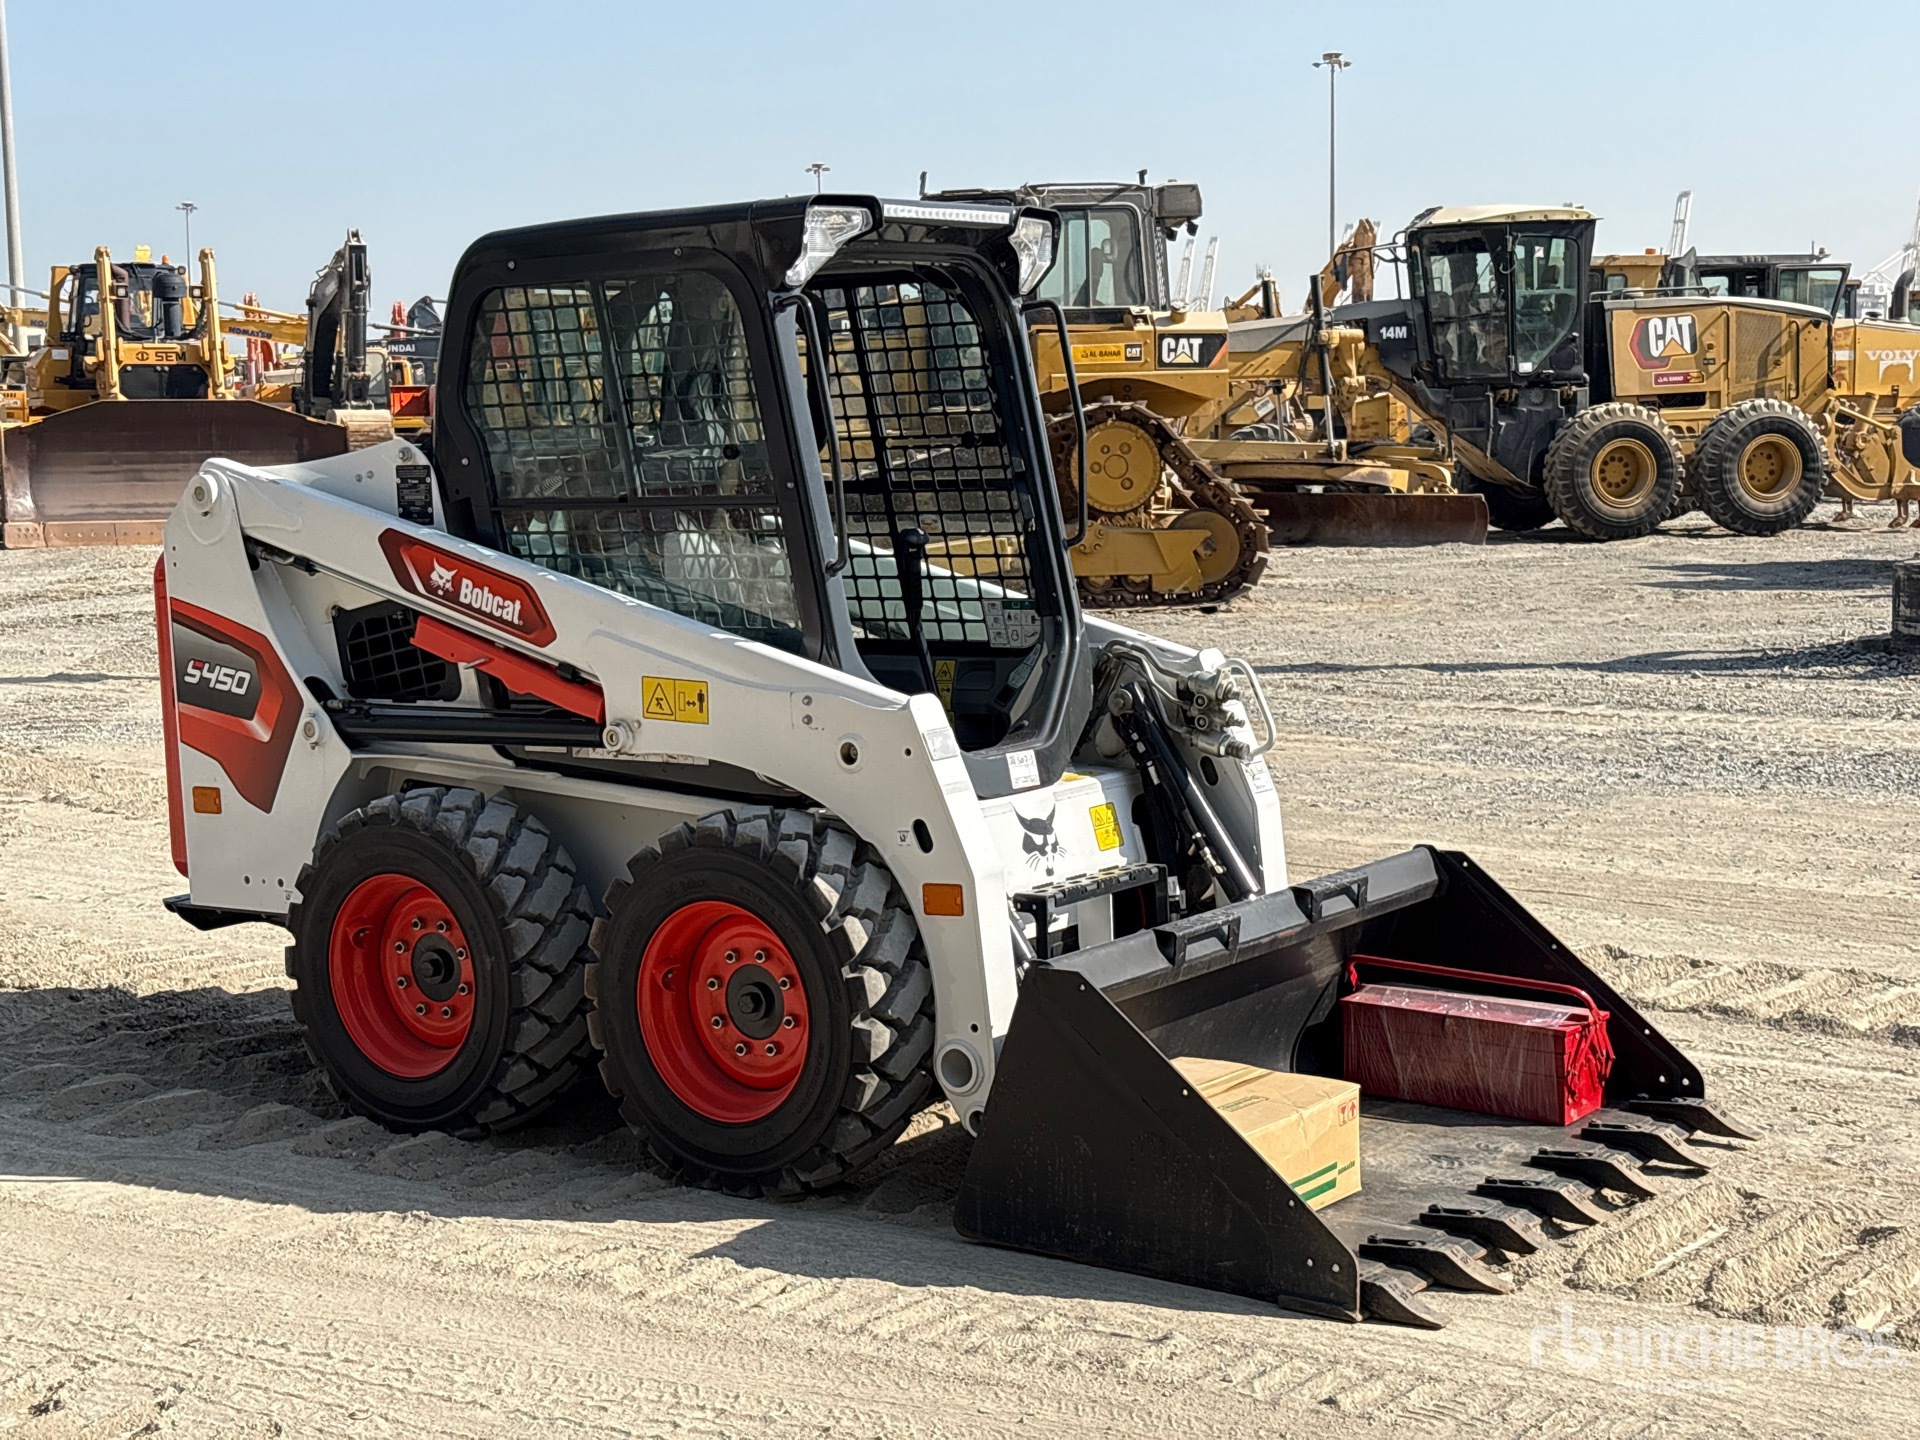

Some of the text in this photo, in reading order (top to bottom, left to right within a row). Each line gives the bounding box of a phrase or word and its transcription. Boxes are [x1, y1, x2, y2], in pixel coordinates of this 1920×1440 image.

[228, 326, 273, 339] KOMATSU
[1379, 326, 1407, 340] 14M
[1648, 316, 1692, 357] CAT
[155, 351, 187, 362] SEM
[1089, 350, 1121, 358] AL-BAHAR
[1126, 347, 1141, 358] CAT
[1162, 337, 1203, 363] CAT
[1864, 349, 1920, 361] VOLV
[458, 577, 521, 625] Bobcat
[184, 659, 251, 696] S450
